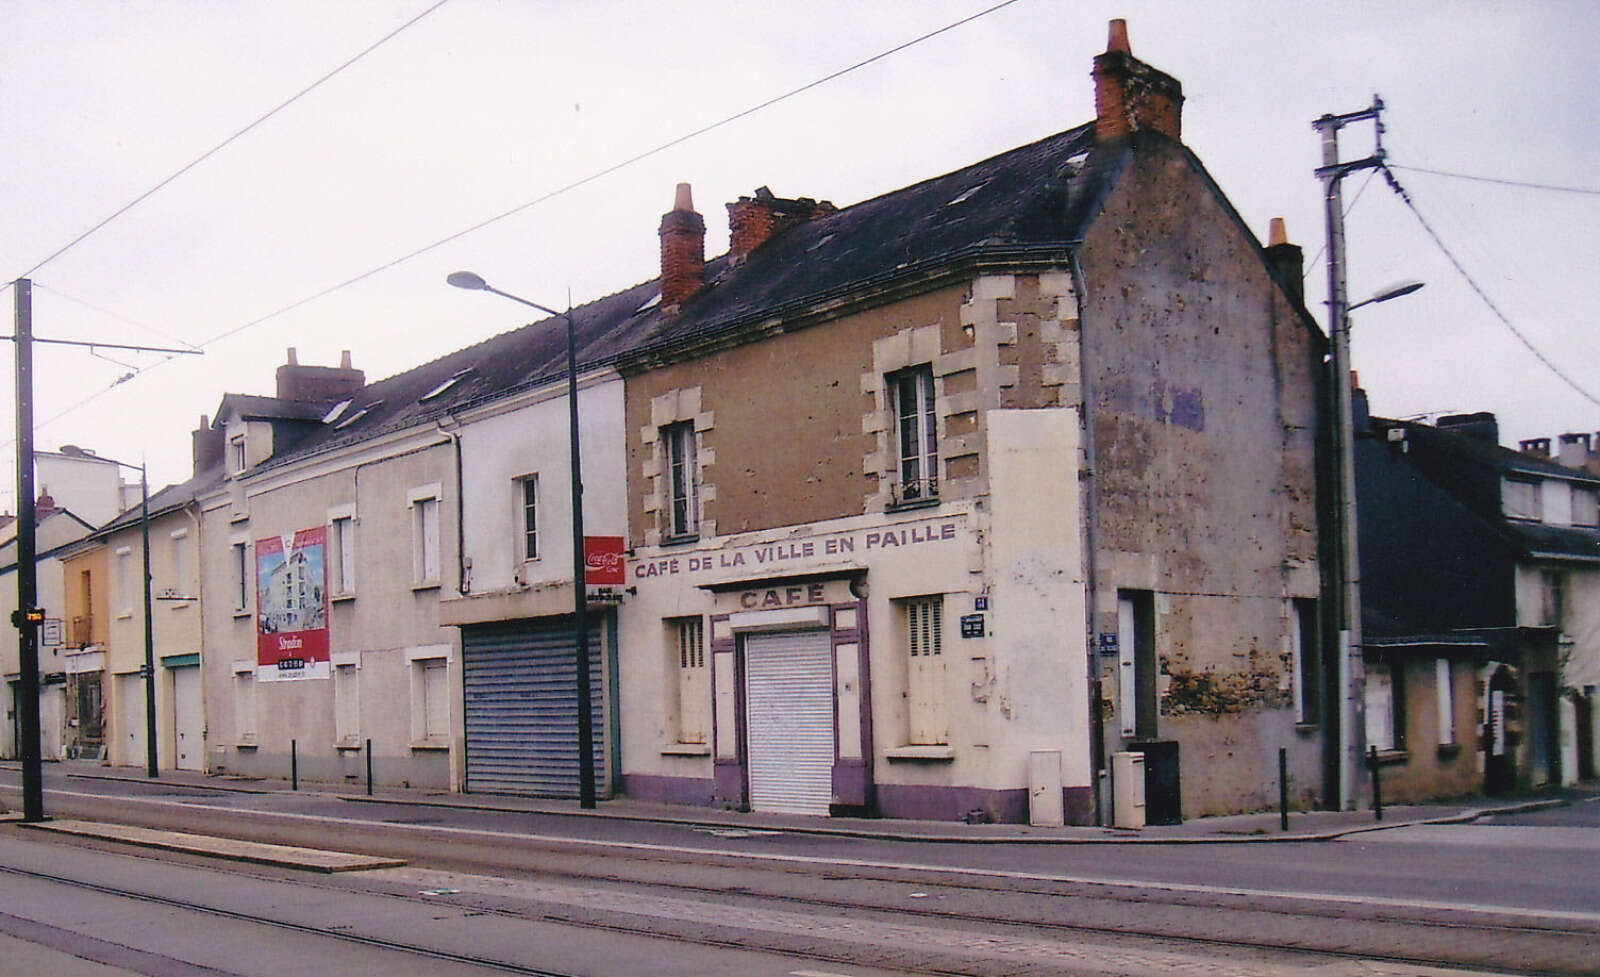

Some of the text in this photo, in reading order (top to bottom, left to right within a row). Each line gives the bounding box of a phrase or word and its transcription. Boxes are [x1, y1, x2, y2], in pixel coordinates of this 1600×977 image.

[689, 556, 713, 572] DE
[720, 552, 746, 568] LA
[755, 542, 815, 563] VILLE
[825, 536, 855, 555] EN
[866, 523, 957, 549] PAILLE
